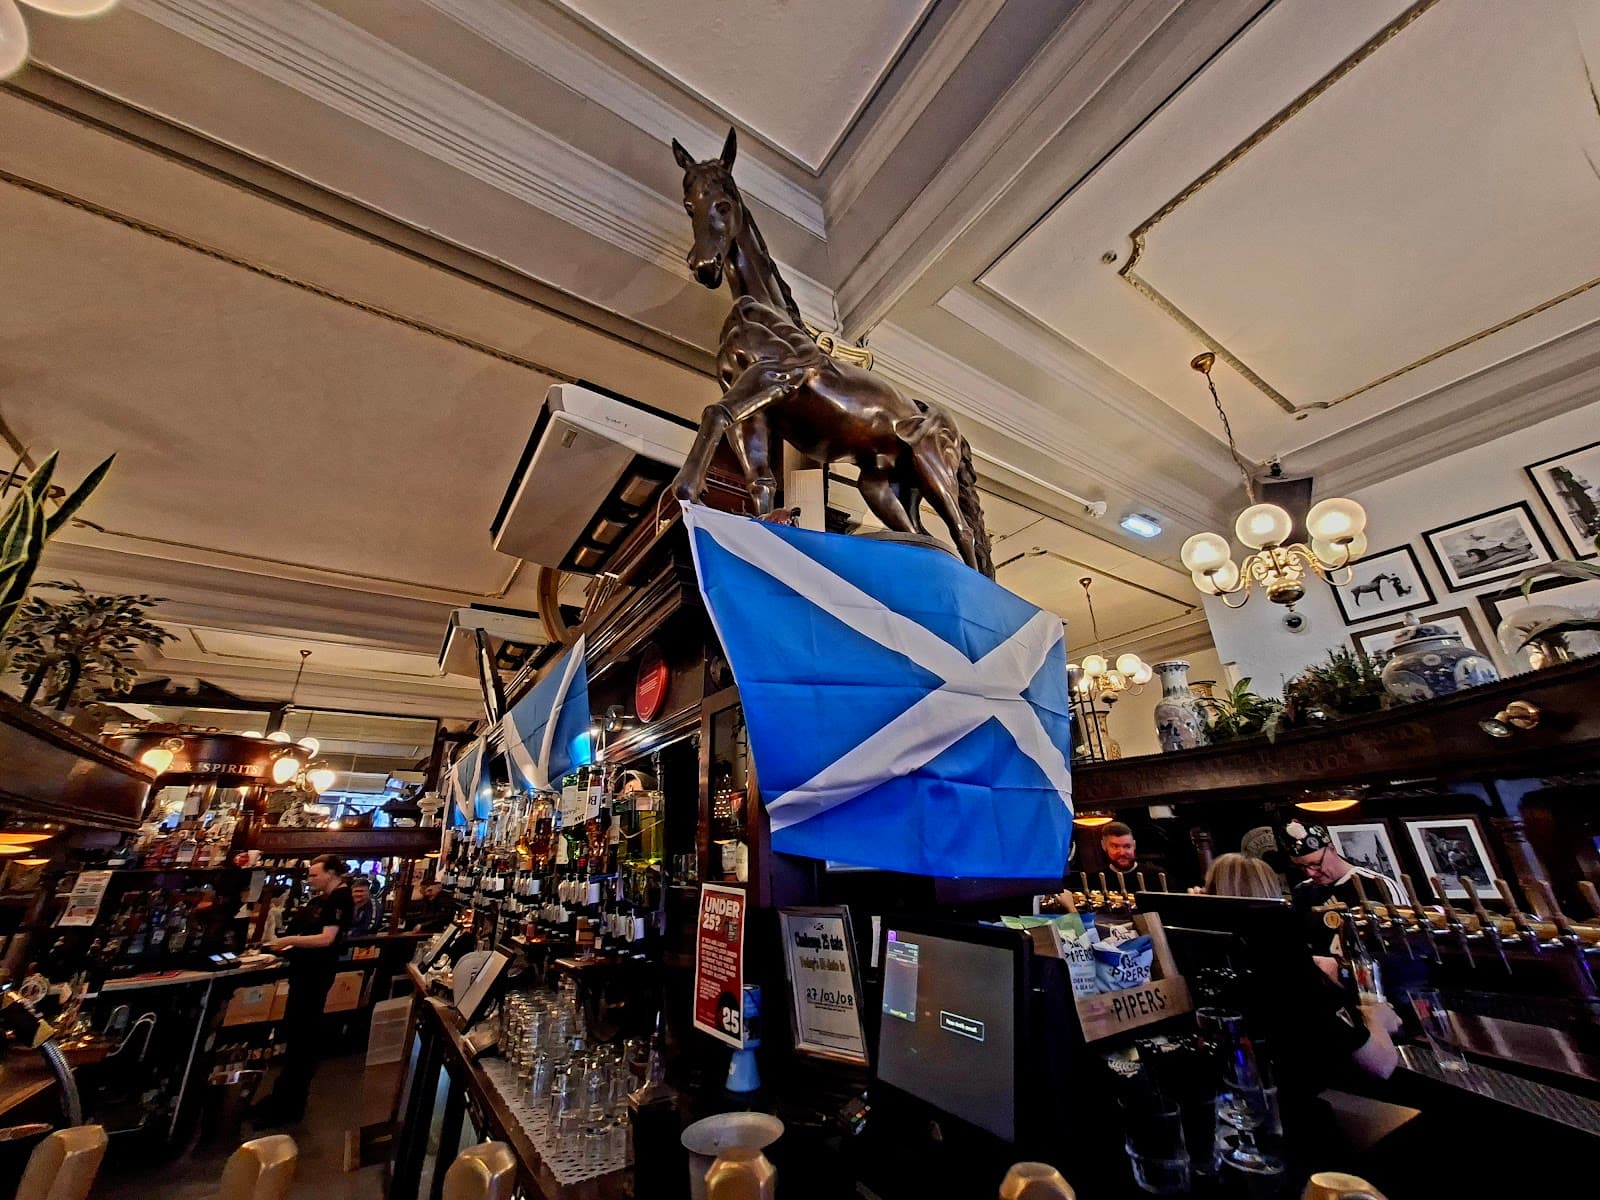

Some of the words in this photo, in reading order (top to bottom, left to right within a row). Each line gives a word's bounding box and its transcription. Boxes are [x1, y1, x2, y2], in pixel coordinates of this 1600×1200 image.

[202, 763, 260, 774] SPIRITS
[704, 896, 740, 919] UNDER
[702, 913, 721, 931] 25?
[722, 1006, 740, 1034] 25
